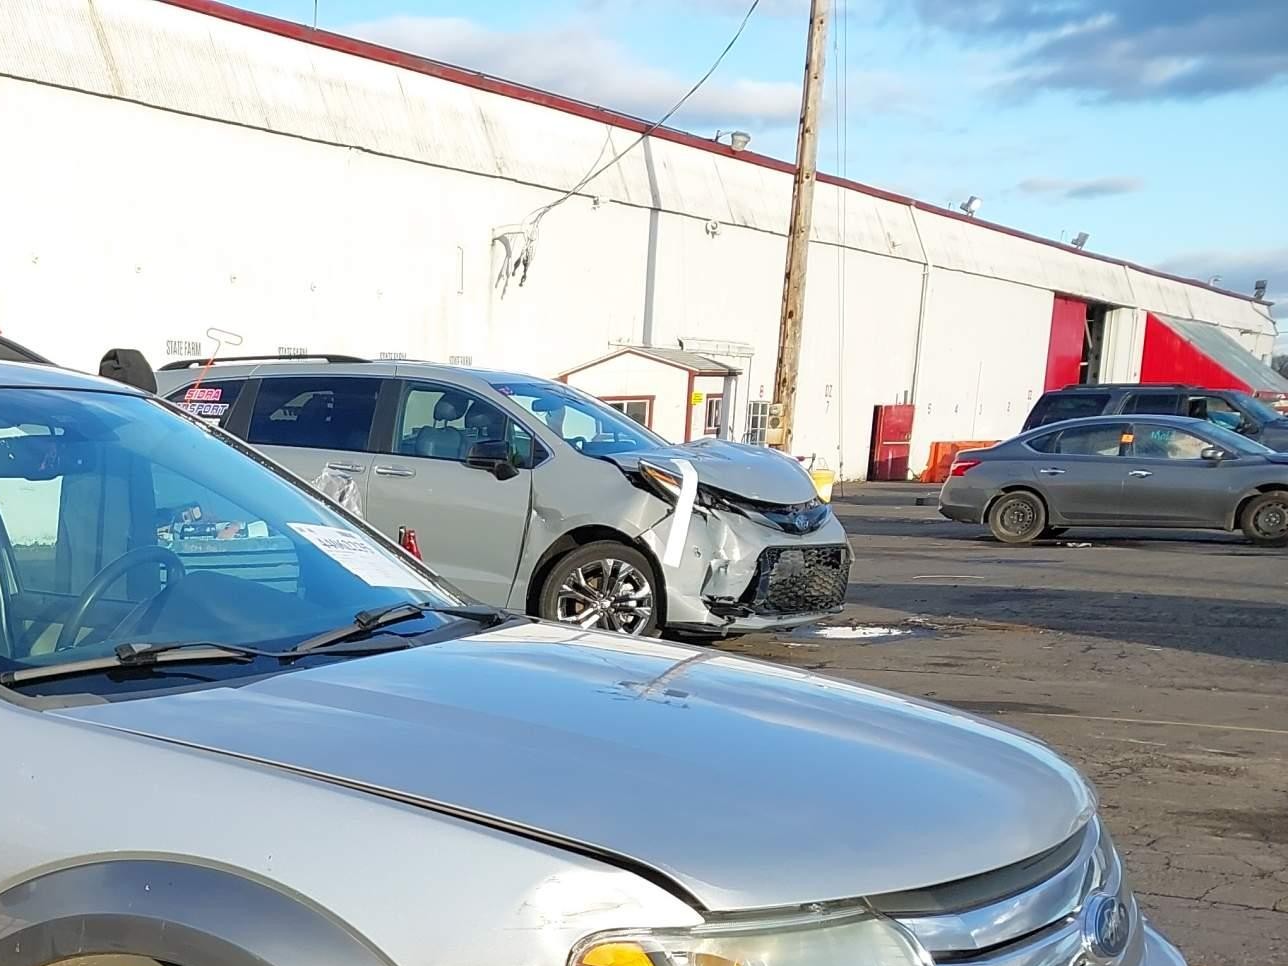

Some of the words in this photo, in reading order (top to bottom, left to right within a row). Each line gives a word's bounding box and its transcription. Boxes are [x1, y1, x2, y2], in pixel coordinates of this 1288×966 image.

[166, 340, 183, 356] STATE
[184, 341, 202, 357] FARM
[185, 389, 222, 400] SIDRA
